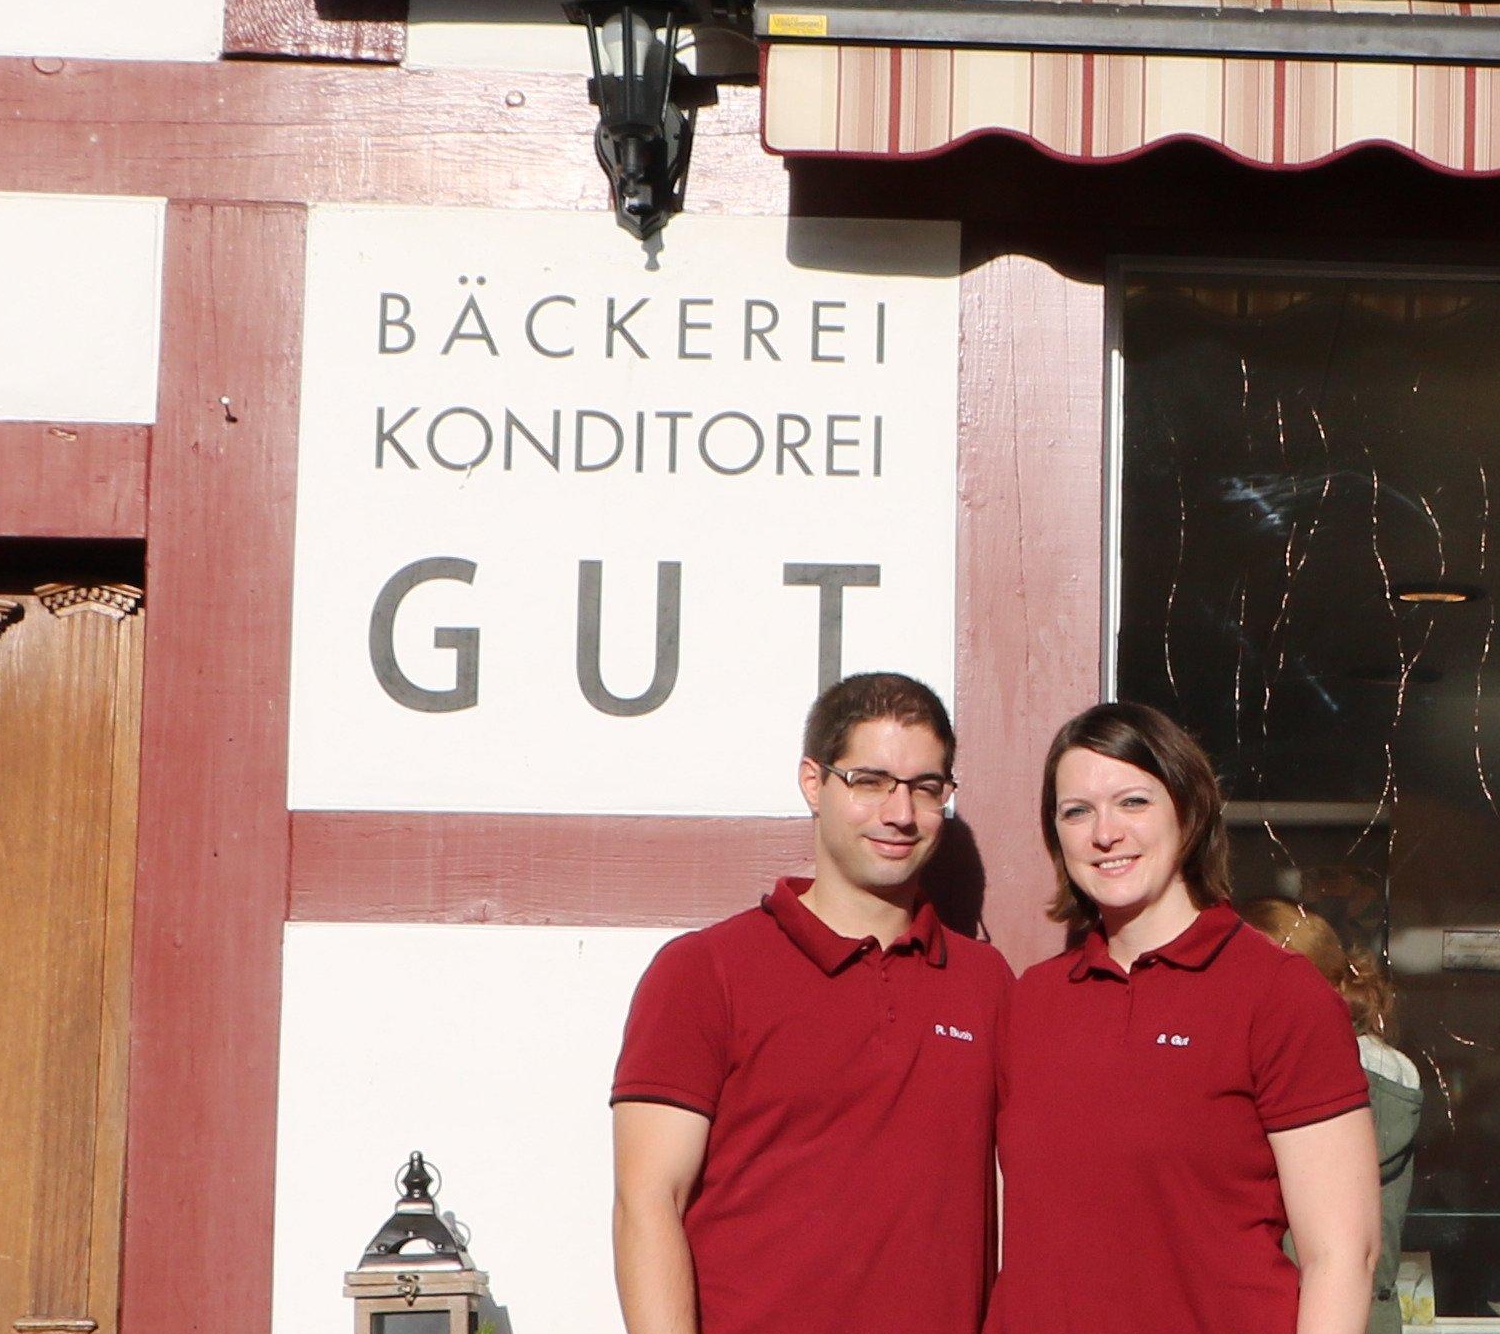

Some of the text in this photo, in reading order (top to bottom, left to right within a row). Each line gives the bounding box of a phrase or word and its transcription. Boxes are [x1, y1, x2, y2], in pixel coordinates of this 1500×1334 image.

[376, 275, 887, 365] BÄCKEREI
[373, 405, 884, 478] KONDITOREI
[367, 555, 882, 718] GUT
